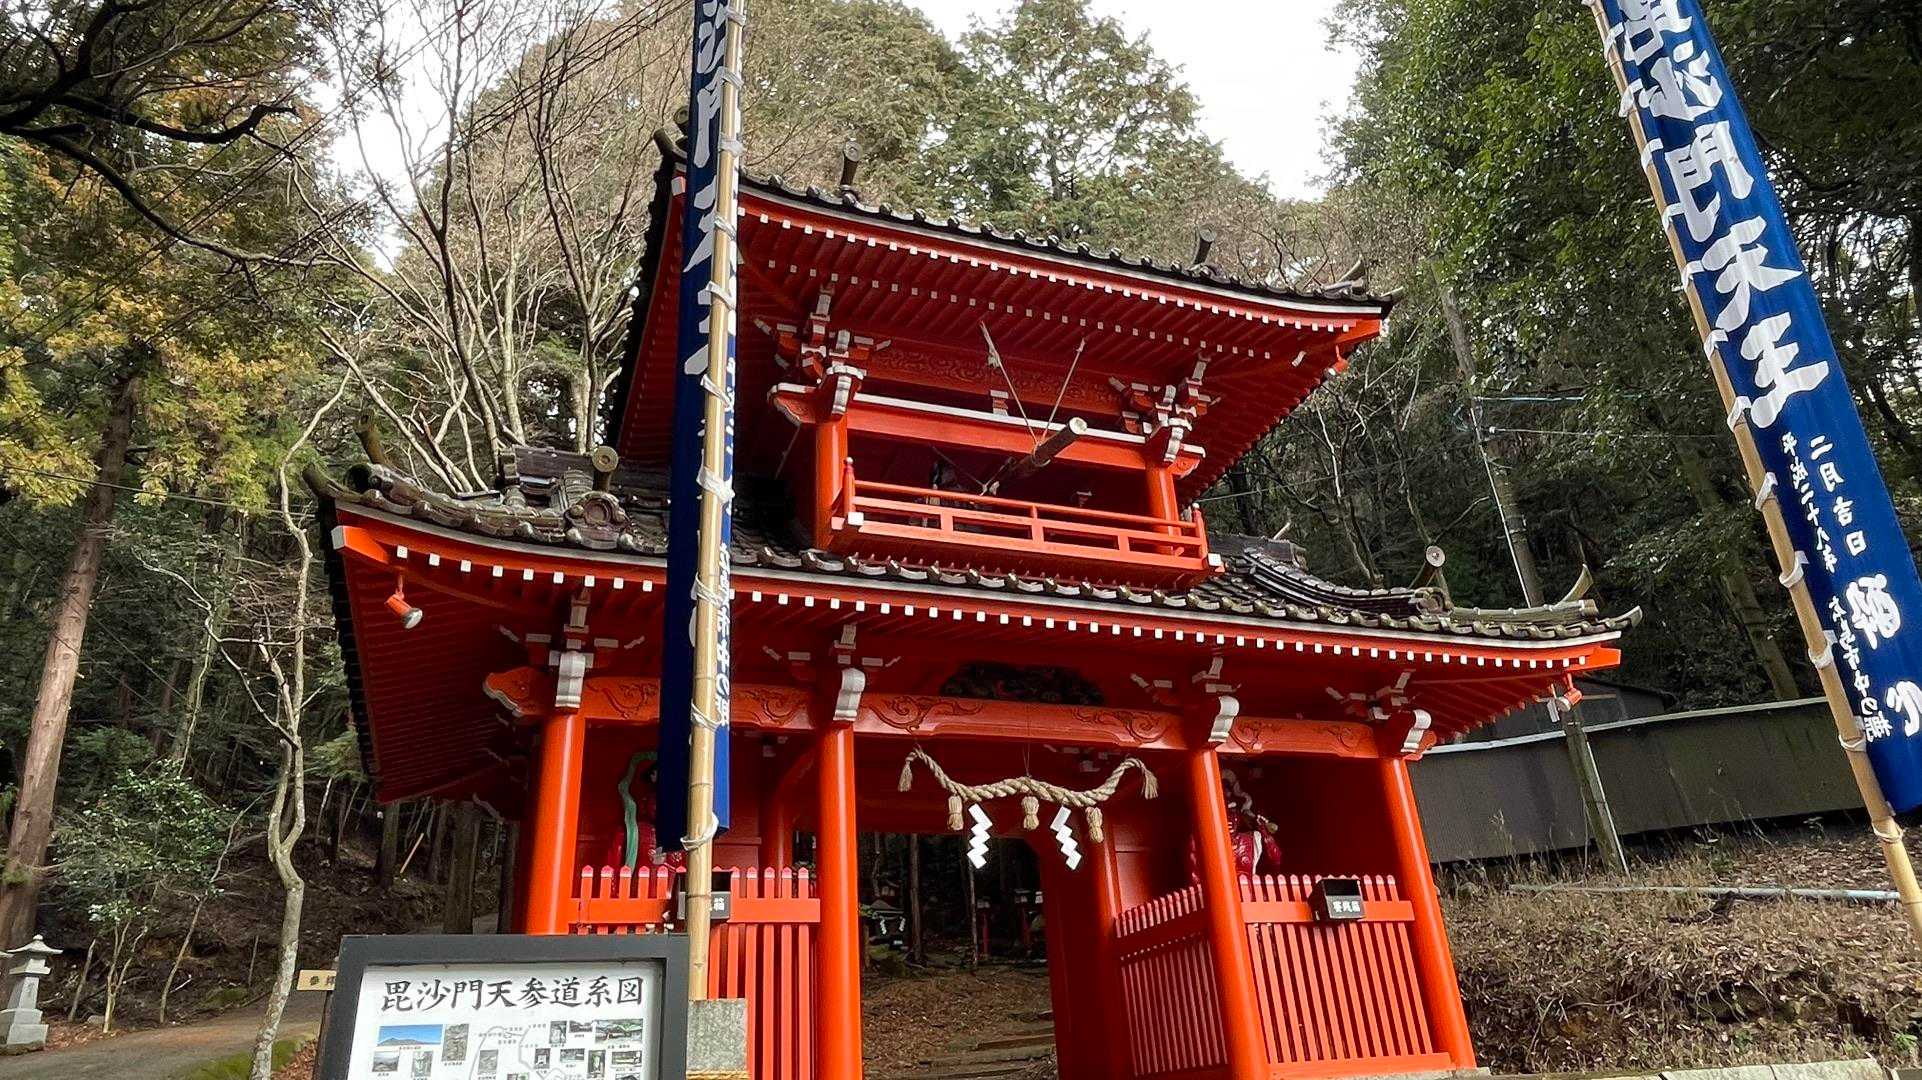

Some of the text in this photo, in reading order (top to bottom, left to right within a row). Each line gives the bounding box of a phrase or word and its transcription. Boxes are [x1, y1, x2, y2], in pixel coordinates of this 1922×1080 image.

[1810, 435, 1867, 557] 二月吉日
[381, 976, 644, 1012] 毘沙門天参道系図
